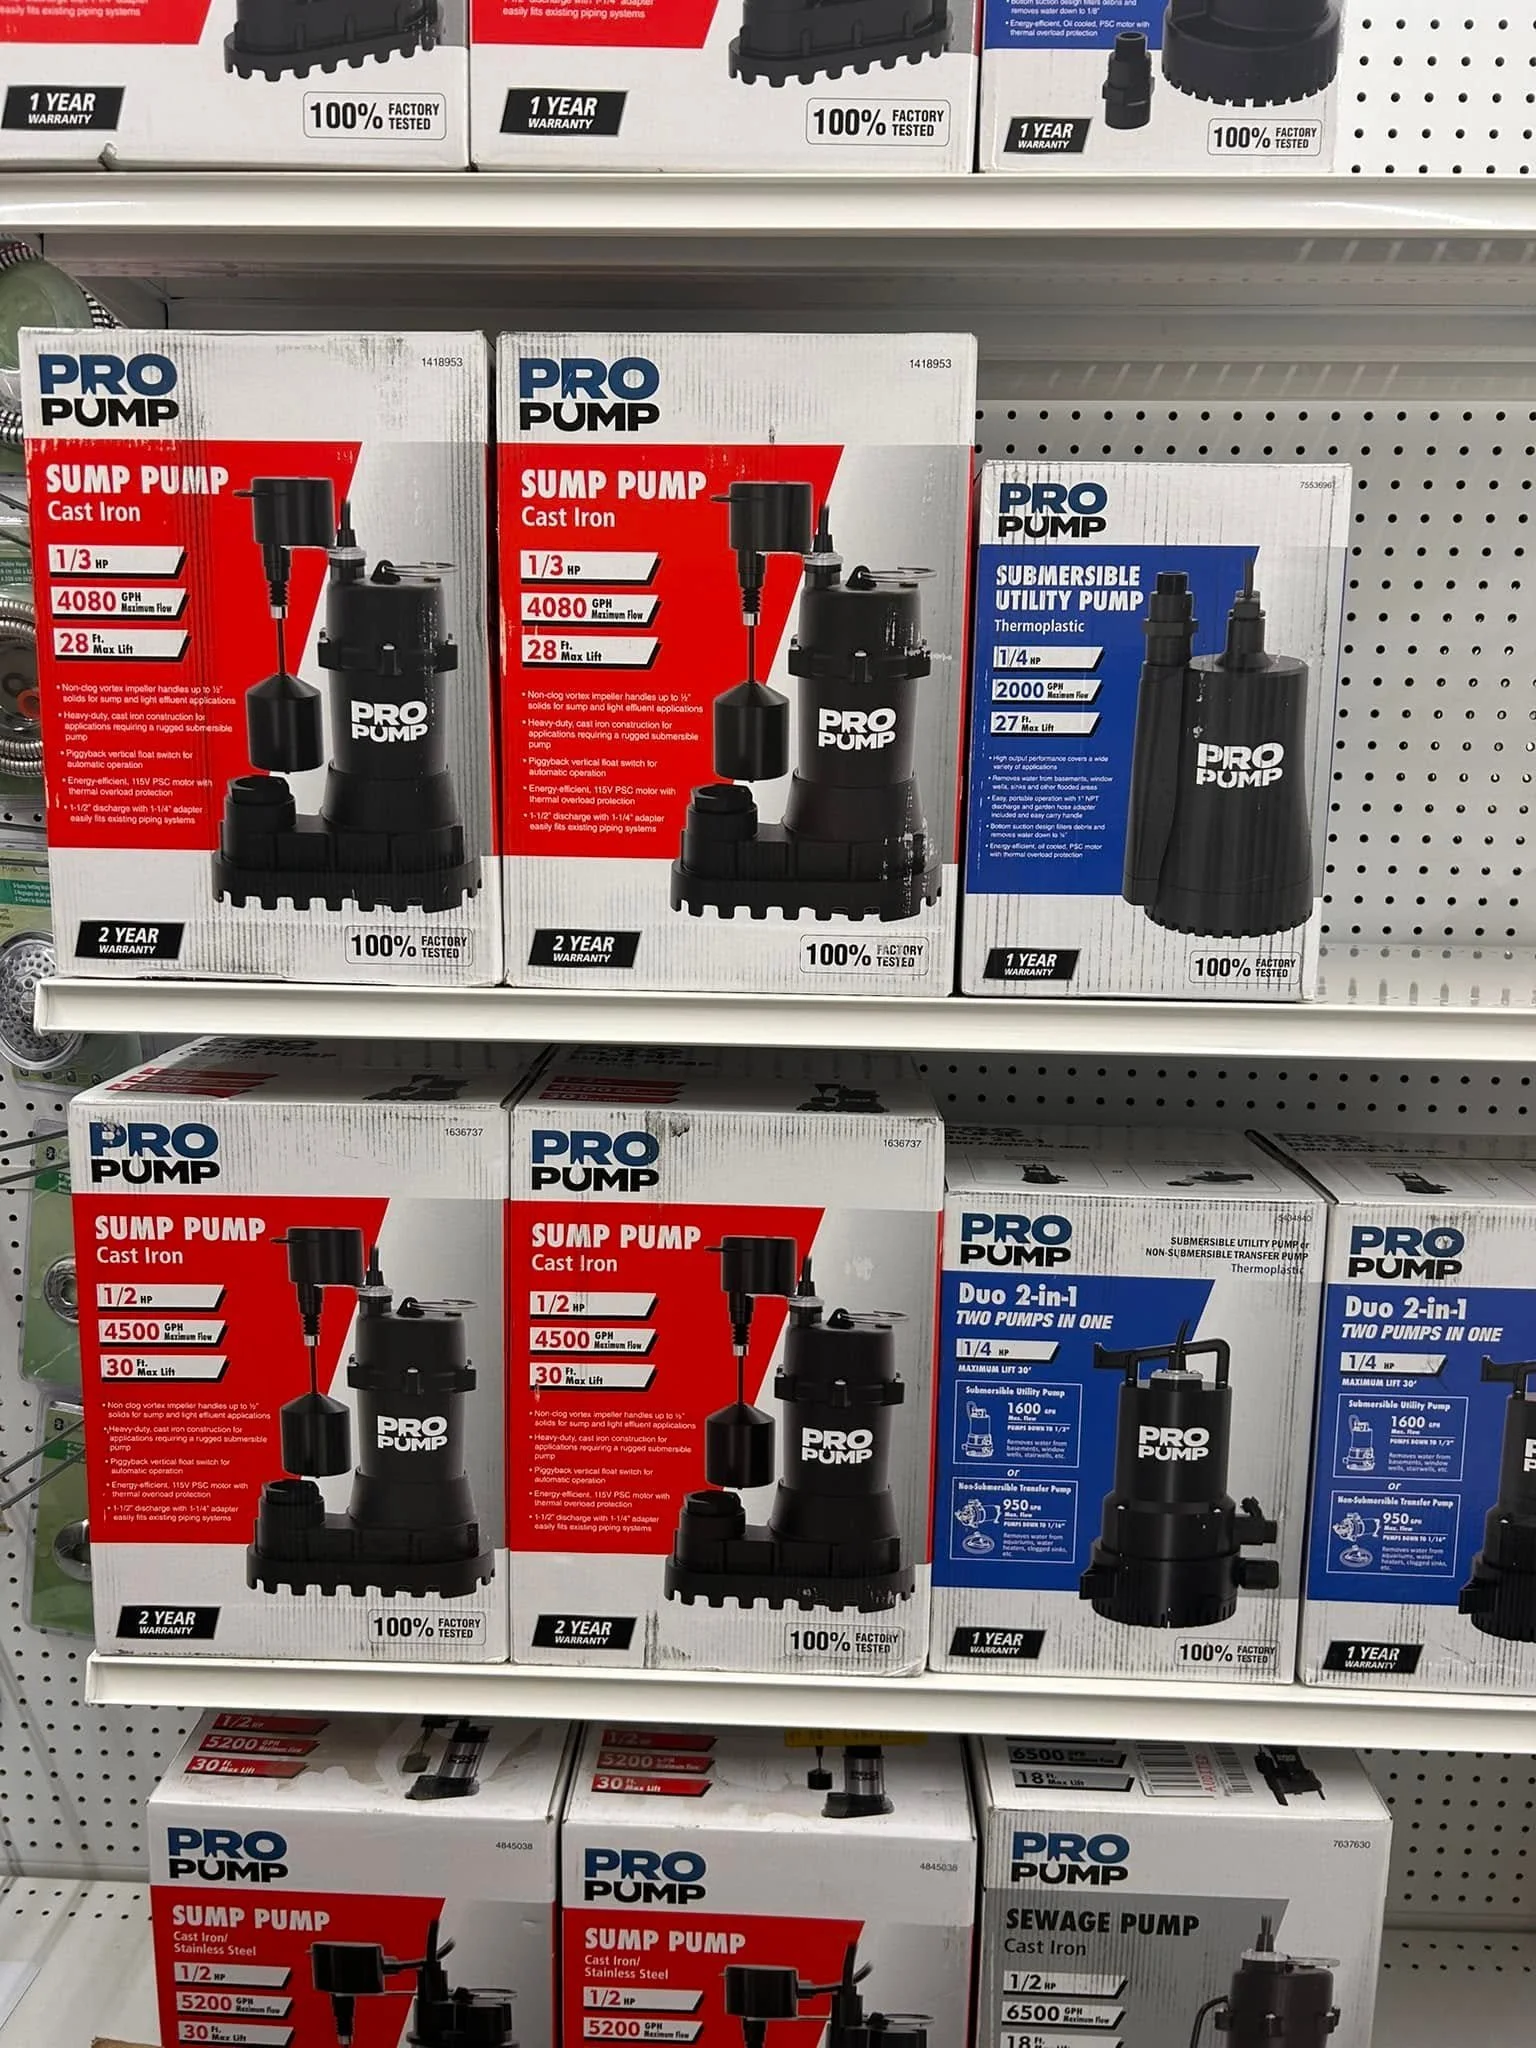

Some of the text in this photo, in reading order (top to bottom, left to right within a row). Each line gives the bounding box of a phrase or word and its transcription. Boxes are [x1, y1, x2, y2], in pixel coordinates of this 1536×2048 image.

[30, 93, 96, 111] 1 YEAR
[531, 96, 598, 116] 1 YEAR
[28, 114, 92, 124] WARRANTY
[310, 102, 439, 130] 100% FACTORY
[388, 117, 431, 130] TESTED
[528, 118, 593, 129] WARRANTY
[813, 108, 944, 136] 100% FACTORY
[892, 124, 934, 136] TESTED
[1021, 123, 1074, 138] 1 YEAR
[1214, 127, 1317, 148] 100% FACTORY
[1018, 140, 1070, 149] WARRANTY
[1275, 138, 1309, 149] TESTED
[422, 357, 463, 367] 1418953
[910, 358, 952, 369] 1418953
[38, 353, 178, 396] PRO
[519, 357, 660, 401] PRO
[41, 398, 179, 427] PUMP
[519, 402, 660, 432] PUMP
[46, 464, 229, 495] SUMP PUMP
[521, 469, 706, 500] SUMP PUMP
[1000, 482, 1108, 515] PRO
[48, 500, 140, 522] Cast Iron
[522, 506, 615, 527] Cast Iron
[1000, 515, 1106, 538] PUMP
[56, 549, 108, 571] 1/3 HP
[529, 554, 581, 577] 1/3 HP
[996, 565, 1140, 586] SUBMERSIBLE
[57, 590, 141, 612] 4080 GPH
[121, 602, 172, 613] Maximum Flow
[527, 597, 612, 618] 4080 GPH
[996, 590, 1144, 611] UTILITY PUMP
[994, 619, 1084, 635] Thermoplastic
[60, 633, 104, 653] 28 Ft.
[93, 644, 133, 654] Max Lift
[1000, 649, 1041, 666] 1/4 HP
[996, 682, 1064, 698] 2000 GPH
[351, 700, 427, 726] PRO
[819, 708, 896, 733] PRO
[352, 723, 428, 742] PUMP
[818, 731, 896, 750] PUMP
[528, 757, 658, 768] Piggyback vertical float switch for
[1197, 743, 1284, 770] PRO
[528, 768, 606, 778] automatic operation
[1196, 767, 1283, 788] PUMP
[98, 927, 159, 943] 2 YEAR
[553, 935, 615, 952] 2 YEAR
[99, 944, 156, 954] WARRANTY
[351, 934, 467, 957] 100% FACTORY
[421, 947, 459, 959] TESTED
[553, 953, 611, 963] WARRANTY
[1007, 953, 1057, 967] 1 YEAR
[1004, 968, 1053, 976] WARRANTY
[89, 1121, 219, 1159] PRO
[444, 1128, 483, 1137] 1636737
[532, 1130, 659, 1167] PRO
[91, 1159, 220, 1184] PUMP
[532, 1166, 659, 1192] PUMP
[95, 1215, 265, 1241] SUMP PUMP
[532, 1223, 701, 1250] SUMP PUMP
[961, 1213, 1072, 1245] PRO
[1170, 1237, 1236, 1247] SUBMERSIBLE
[1237, 1239, 1270, 1248] UTILITY
[1271, 1238, 1298, 1248] PUMP
[1350, 1225, 1465, 1258] PRO
[97, 1246, 183, 1264] Cast Iron
[532, 1254, 617, 1272] Cast Iron
[960, 1244, 1071, 1267] PUMP
[1145, 1248, 1309, 1261] NON-SUBMERSIBLE TRANSFER PUMP
[1348, 1257, 1462, 1280] PUMP
[104, 1287, 153, 1305] 1/2 HP
[959, 1282, 1077, 1307] Duo 2-in-1
[1345, 1295, 1467, 1320] Duo 2-in-1
[956, 1310, 1114, 1329] TWO PUMPS IN ONE
[104, 1322, 183, 1340] 4500 GPH
[965, 1341, 991, 1356] 1/4
[802, 1427, 873, 1450] PRO
[1139, 1425, 1209, 1447] PRO
[802, 1447, 872, 1464] PUMP
[1138, 1445, 1209, 1461] PUMP
[1007, 1469, 1020, 1477] or
[138, 1611, 196, 1625] 2 YEAR
[374, 1617, 481, 1637] 100% FACTORY
[554, 1620, 612, 1635] 2 YEAR
[139, 1626, 193, 1634] WARRANTY
[438, 1628, 473, 1638] TESTED
[555, 1635, 608, 1645] WARRANTY
[167, 1827, 287, 1861] PRO
[495, 1842, 533, 1850] 4845038
[1012, 1831, 1130, 1864] PRO
[169, 1858, 288, 1883] PUMP
[584, 1848, 706, 1882] PRO
[1011, 1862, 1128, 1886] PUMP
[584, 1880, 706, 1904] PUMP
[172, 1905, 330, 1931] SUMP PUMP
[1006, 1908, 1199, 1936] SEWAGE PUMP
[174, 1943, 256, 1956] Stainless Steel
[585, 1928, 746, 1954] SUMP PUMP
[1004, 1938, 1086, 1956] Cast Iron
